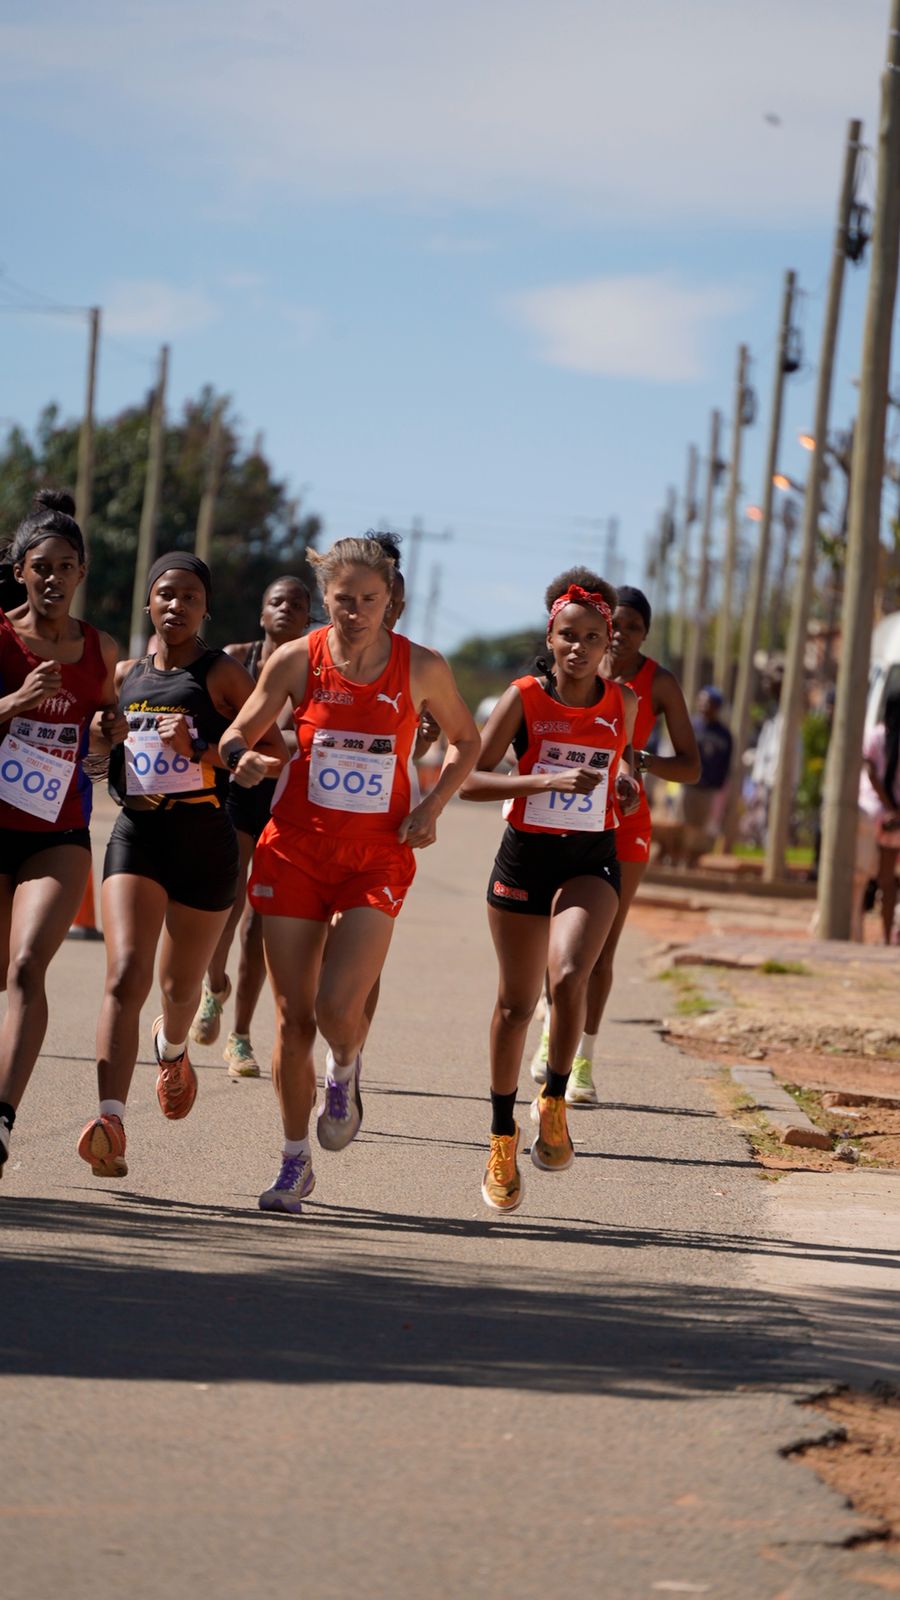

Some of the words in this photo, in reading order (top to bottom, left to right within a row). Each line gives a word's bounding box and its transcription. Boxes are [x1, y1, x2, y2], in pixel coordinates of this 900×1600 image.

[37, 727, 56, 740] 2026
[342, 738, 364, 750] 2026
[133, 751, 190, 776] 066
[565, 750, 586, 764] 2026
[1, 759, 62, 801] 008
[319, 767, 383, 796] 005
[548, 791, 593, 813] 193
